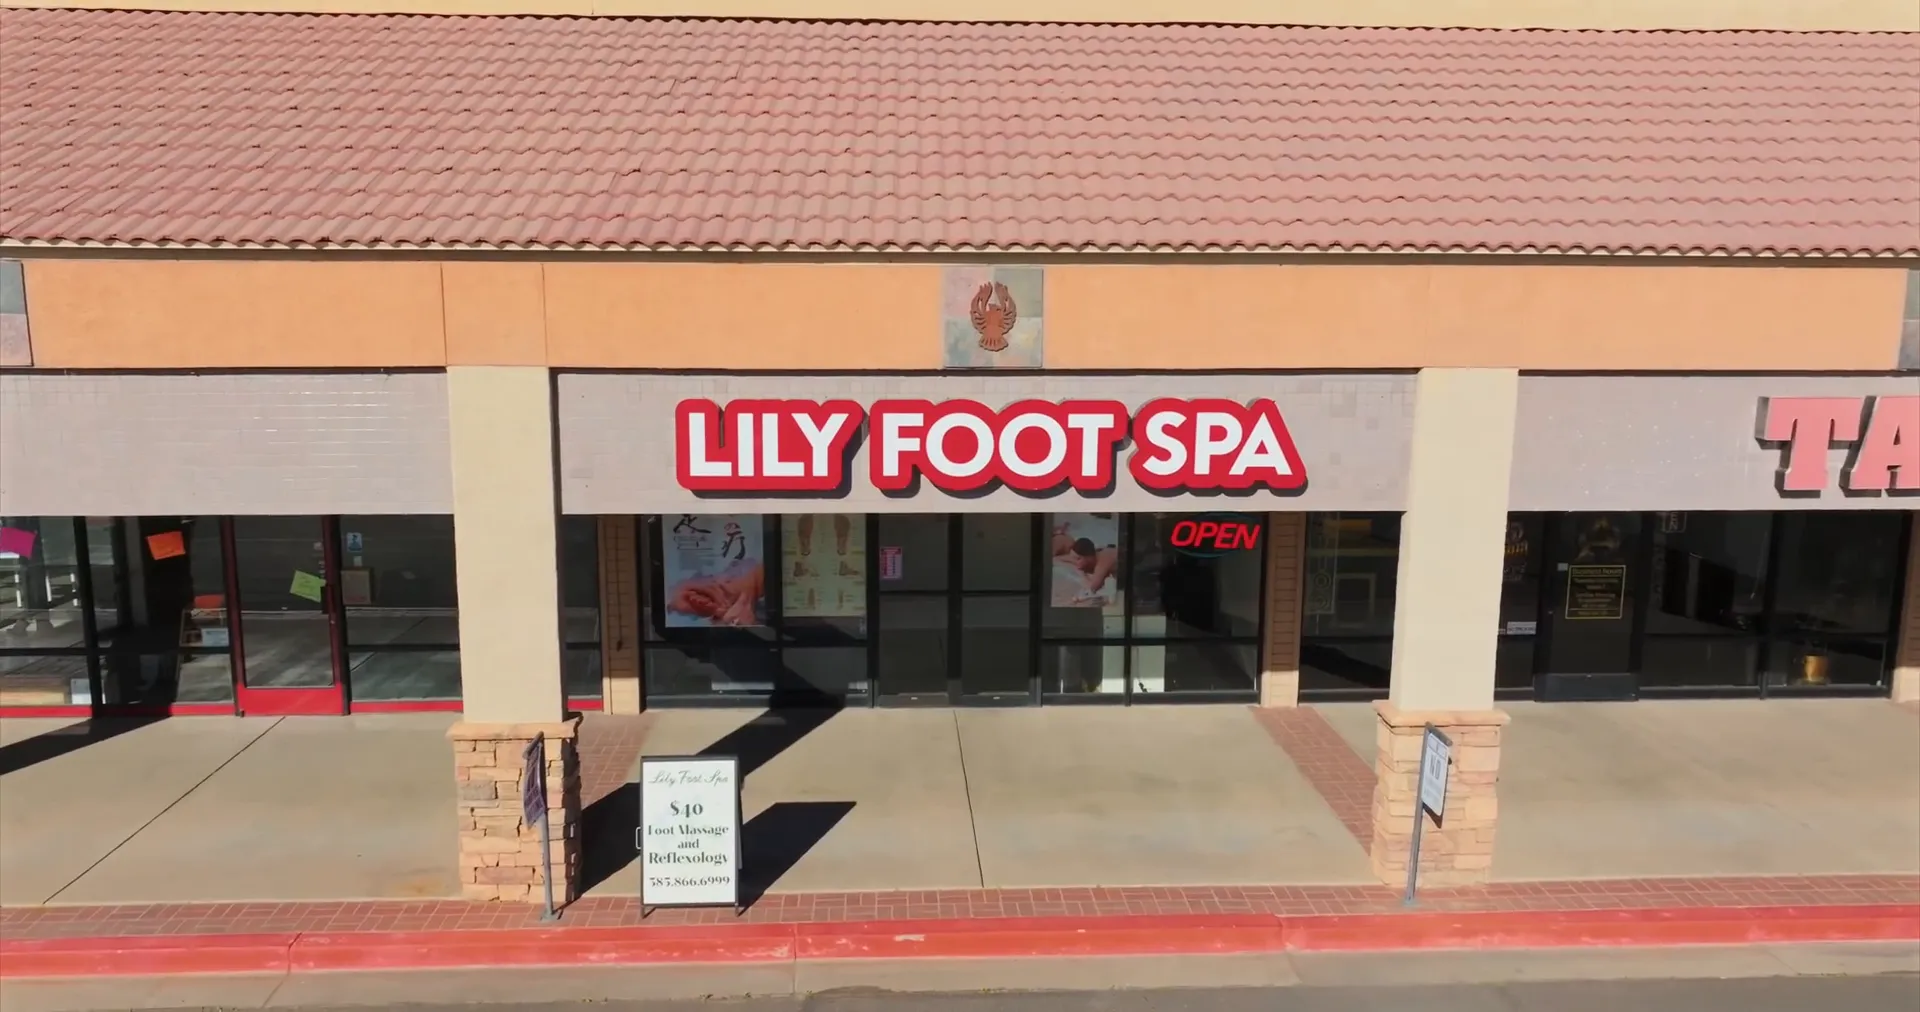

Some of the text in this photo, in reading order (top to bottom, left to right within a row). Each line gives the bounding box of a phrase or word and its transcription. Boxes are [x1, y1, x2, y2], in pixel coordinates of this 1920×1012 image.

[687, 410, 1294, 477] LILY FOOT SPA
[1171, 520, 1261, 550] OPEN
[648, 770, 729, 787] Lily Foot Spa
[669, 800, 704, 819] $40
[678, 824, 729, 836] Massage
[677, 838, 700, 849] and
[649, 851, 729, 866] Reflexology
